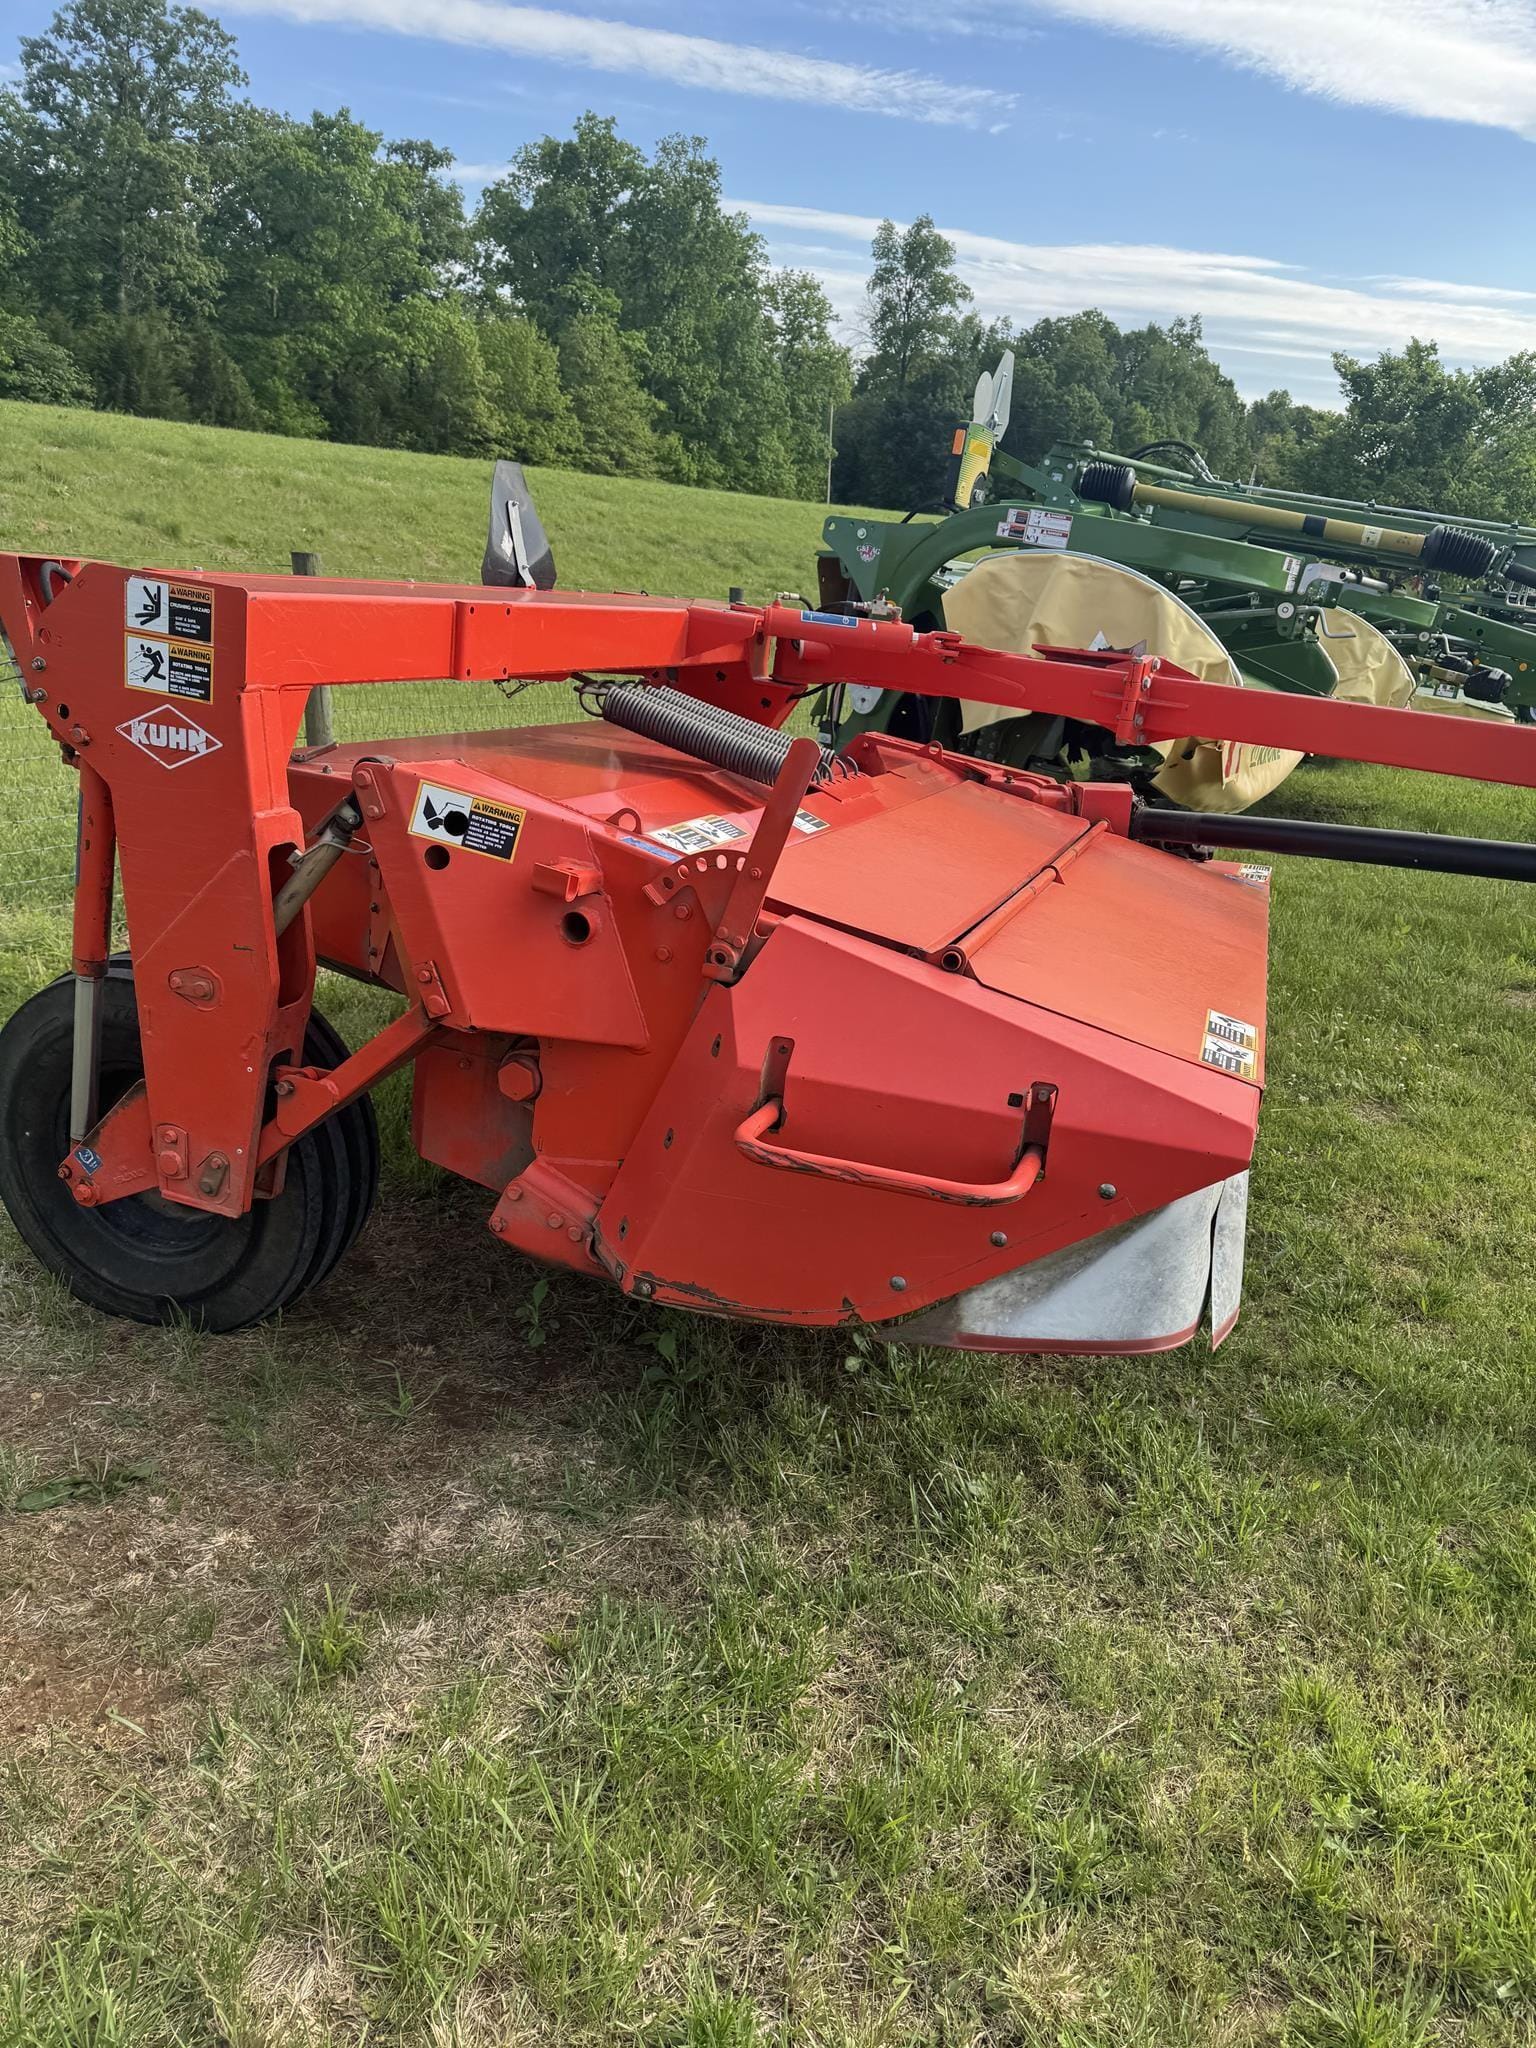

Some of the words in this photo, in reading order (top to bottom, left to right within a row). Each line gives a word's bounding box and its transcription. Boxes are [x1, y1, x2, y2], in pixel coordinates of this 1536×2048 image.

[176, 588, 210, 600] WARNING
[170, 602, 191, 610] CRUSHING
[177, 648, 210, 661] WARNING
[172, 662, 193, 670] ROTATING
[131, 720, 207, 754] KUHN
[482, 804, 520, 821] WARNING
[472, 814, 497, 826] ROTATING
[499, 822, 515, 831] TOOLS
